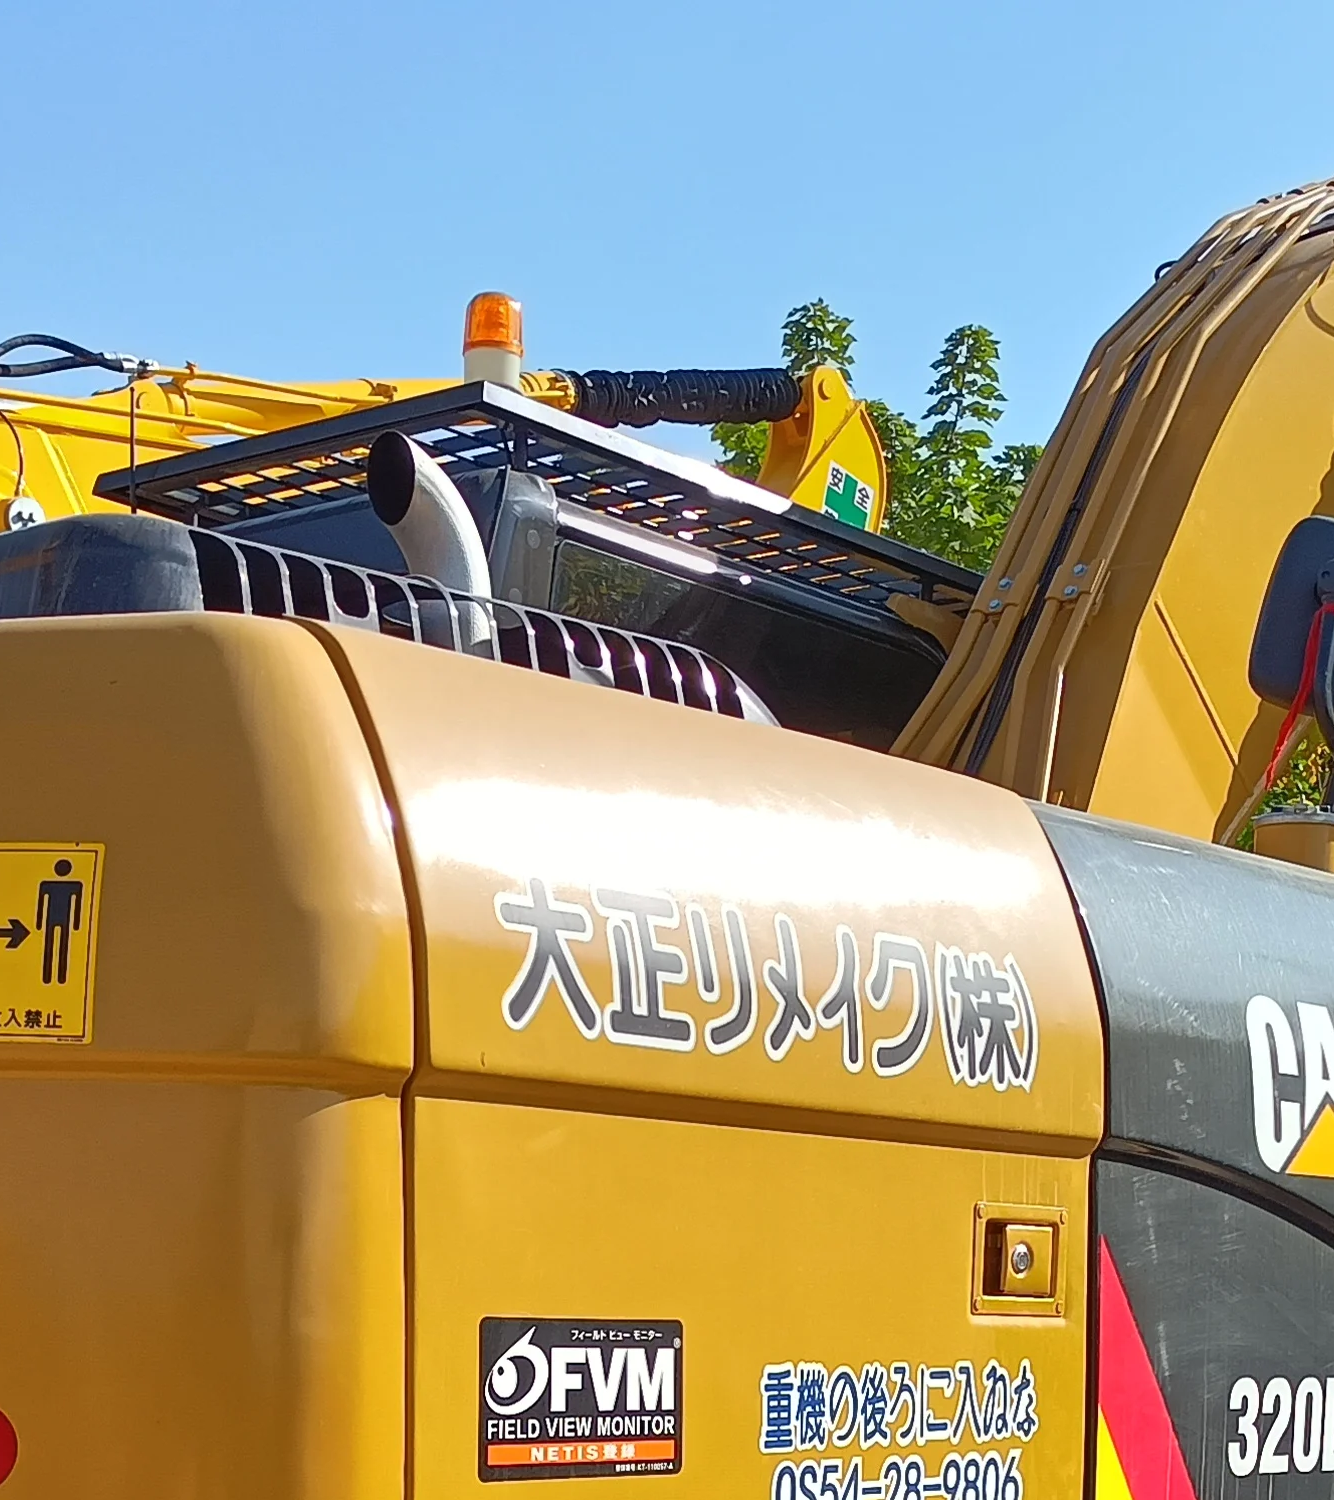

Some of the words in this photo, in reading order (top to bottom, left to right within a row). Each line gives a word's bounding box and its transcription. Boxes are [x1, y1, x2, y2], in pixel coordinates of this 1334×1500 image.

[496, 878, 1038, 1091] 大正リメイク(株)
[550, 1347, 675, 1412] FVM
[487, 1417, 540, 1440] FIELD
[545, 1416, 592, 1438] VIEW
[596, 1415, 675, 1437] MONITOR
